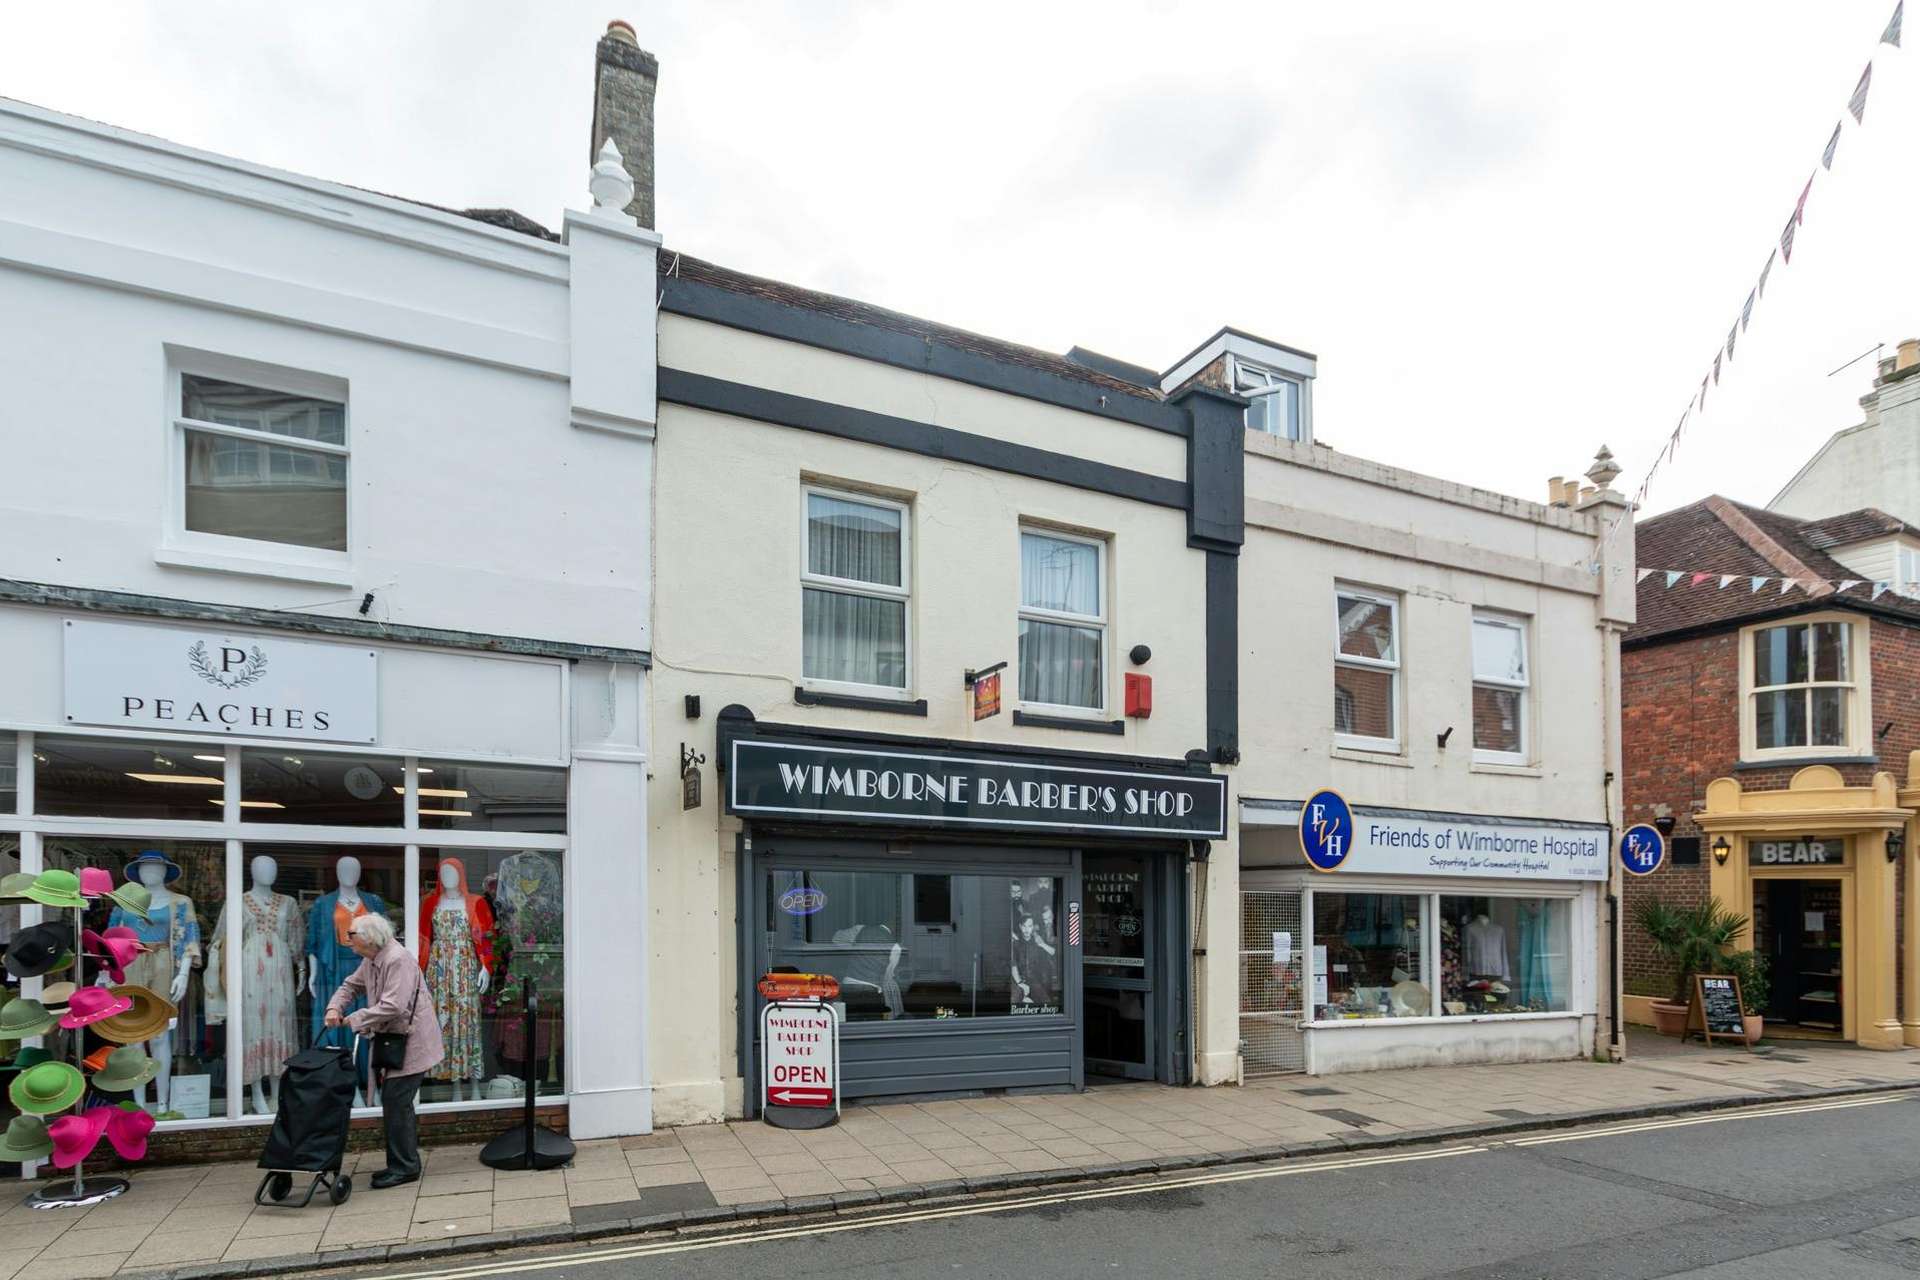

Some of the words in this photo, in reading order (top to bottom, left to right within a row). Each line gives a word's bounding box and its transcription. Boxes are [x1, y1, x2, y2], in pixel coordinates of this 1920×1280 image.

[219, 647, 246, 672] P
[122, 696, 330, 731] PEACHES
[778, 762, 968, 803] WIMBORNE
[977, 777, 1117, 814] BARBER'S
[1124, 787, 1193, 817] SHOP
[1370, 824, 1430, 849] Friends
[1435, 829, 1453, 850] of
[1456, 830, 1538, 854] Wimborne
[1543, 836, 1599, 860] Hospital
[1761, 842, 1826, 863] BEAR
[1429, 856, 1468, 871] Supporting
[1469, 858, 1481, 867] Our
[1482, 858, 1521, 873] Community
[1523, 860, 1550, 873] Hospital
[781, 893, 824, 910] OPEN
[1704, 979, 1730, 989] BEAR
[1010, 1004, 1040, 1015] Barber
[1041, 1003, 1059, 1016] shop
[770, 1018, 828, 1029] WIMBORNE
[778, 1032, 821, 1042] BARBER
[786, 1046, 813, 1056] SHOP
[774, 1065, 826, 1083] OPEN
